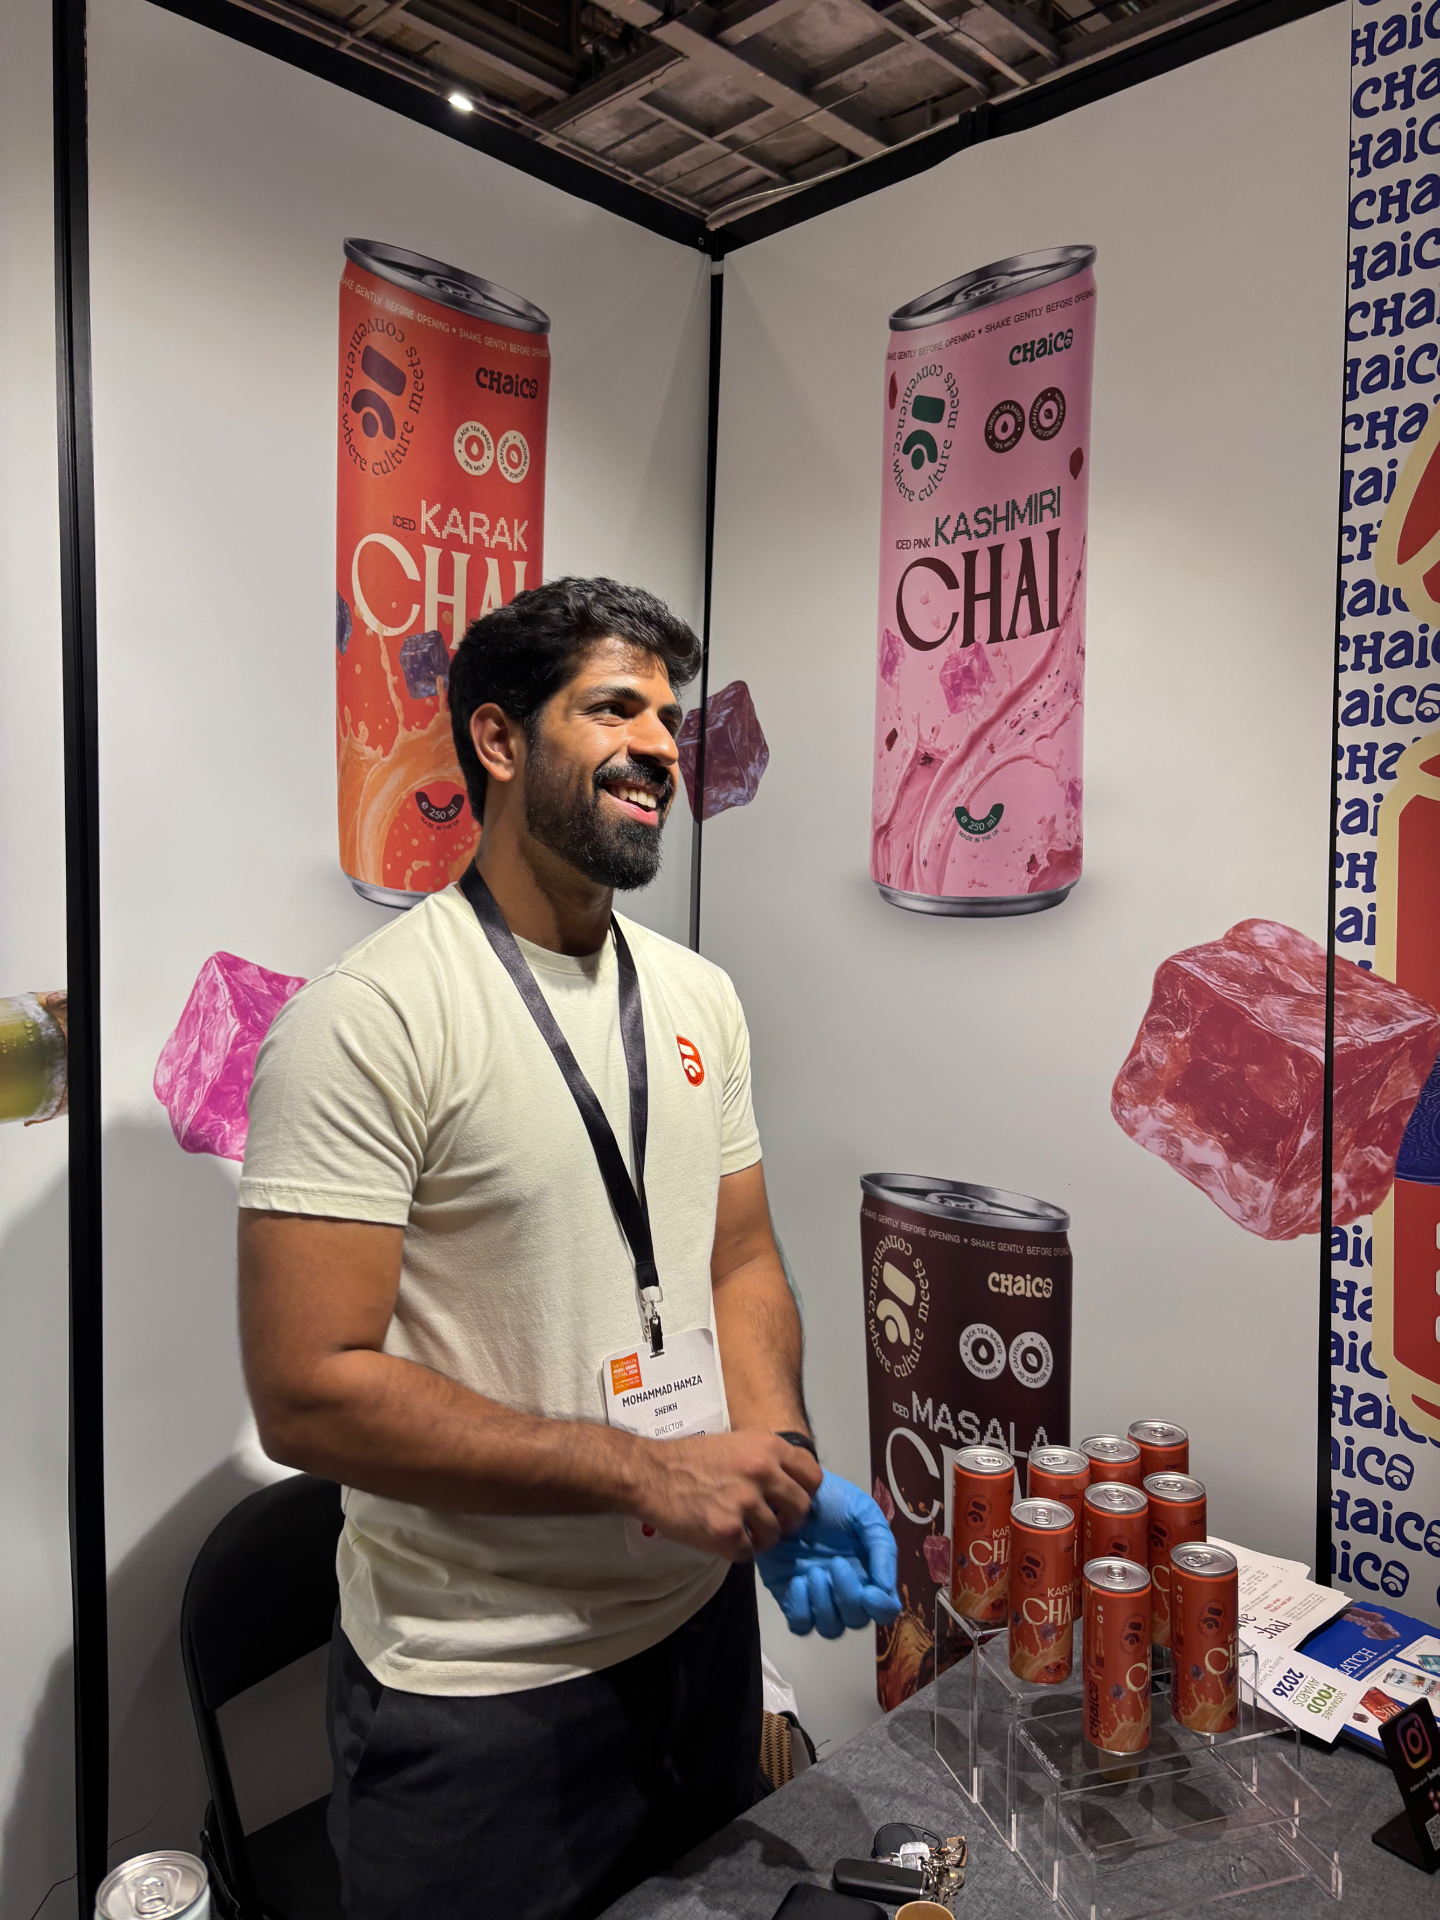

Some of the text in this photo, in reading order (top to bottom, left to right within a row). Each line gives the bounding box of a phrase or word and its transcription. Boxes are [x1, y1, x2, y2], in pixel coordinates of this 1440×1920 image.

[355, 284, 383, 306] GENTLY
[385, 298, 415, 319] BEFORE
[417, 313, 450, 333] OPENING
[459, 328, 482, 344] SHAKE
[484, 336, 508, 351] GENTLY
[918, 342, 943, 357] BEFORE
[945, 329, 976, 348] OPENING
[984, 317, 1011, 334] SHAKE
[1013, 307, 1043, 323] GENTLY
[1045, 297, 1073, 314] BEFORE
[342, 413, 368, 472] where
[372, 420, 414, 477] culture
[405, 346, 425, 416] meets
[892, 459, 915, 502] where
[918, 438, 954, 502] culture
[943, 371, 960, 431] meets
[392, 499, 528, 553] ICED KARAK
[895, 486, 1061, 550] ICED PINK KASHMIRI
[896, 527, 1061, 652] CHAI
[429, 808, 447, 820] 250
[447, 803, 458, 817] ml
[968, 820, 985, 831] 250
[986, 814, 997, 828] ml
[877, 1214, 899, 1228] GENTLY
[900, 1221, 927, 1237] BEFORE
[928, 1229, 960, 1244] OPENING
[970, 1237, 995, 1251] SHAKE
[997, 1241, 1024, 1255] GENTLY
[1026, 1245, 1052, 1257] BEFORE
[868, 1318, 891, 1373] where
[894, 1326, 925, 1379] culture
[913, 1257, 930, 1323] meets
[963, 1327, 1003, 1355] BLACK TEA BASED
[985, 1365, 998, 1376] FREE
[622, 1383, 673, 1408] MOHAMMAD
[674, 1374, 703, 1392] HAMZA
[654, 1402, 678, 1417] SHEIKH
[892, 1390, 1050, 1458] ICED MASALA
[654, 1420, 684, 1437] DIRECTOR
[1272, 1667, 1305, 1699] 2026
[1292, 1676, 1321, 1708] AWARDS
[1306, 1682, 1337, 1714] FOOD
[1321, 1690, 1347, 1721] SUSTAINABLE
